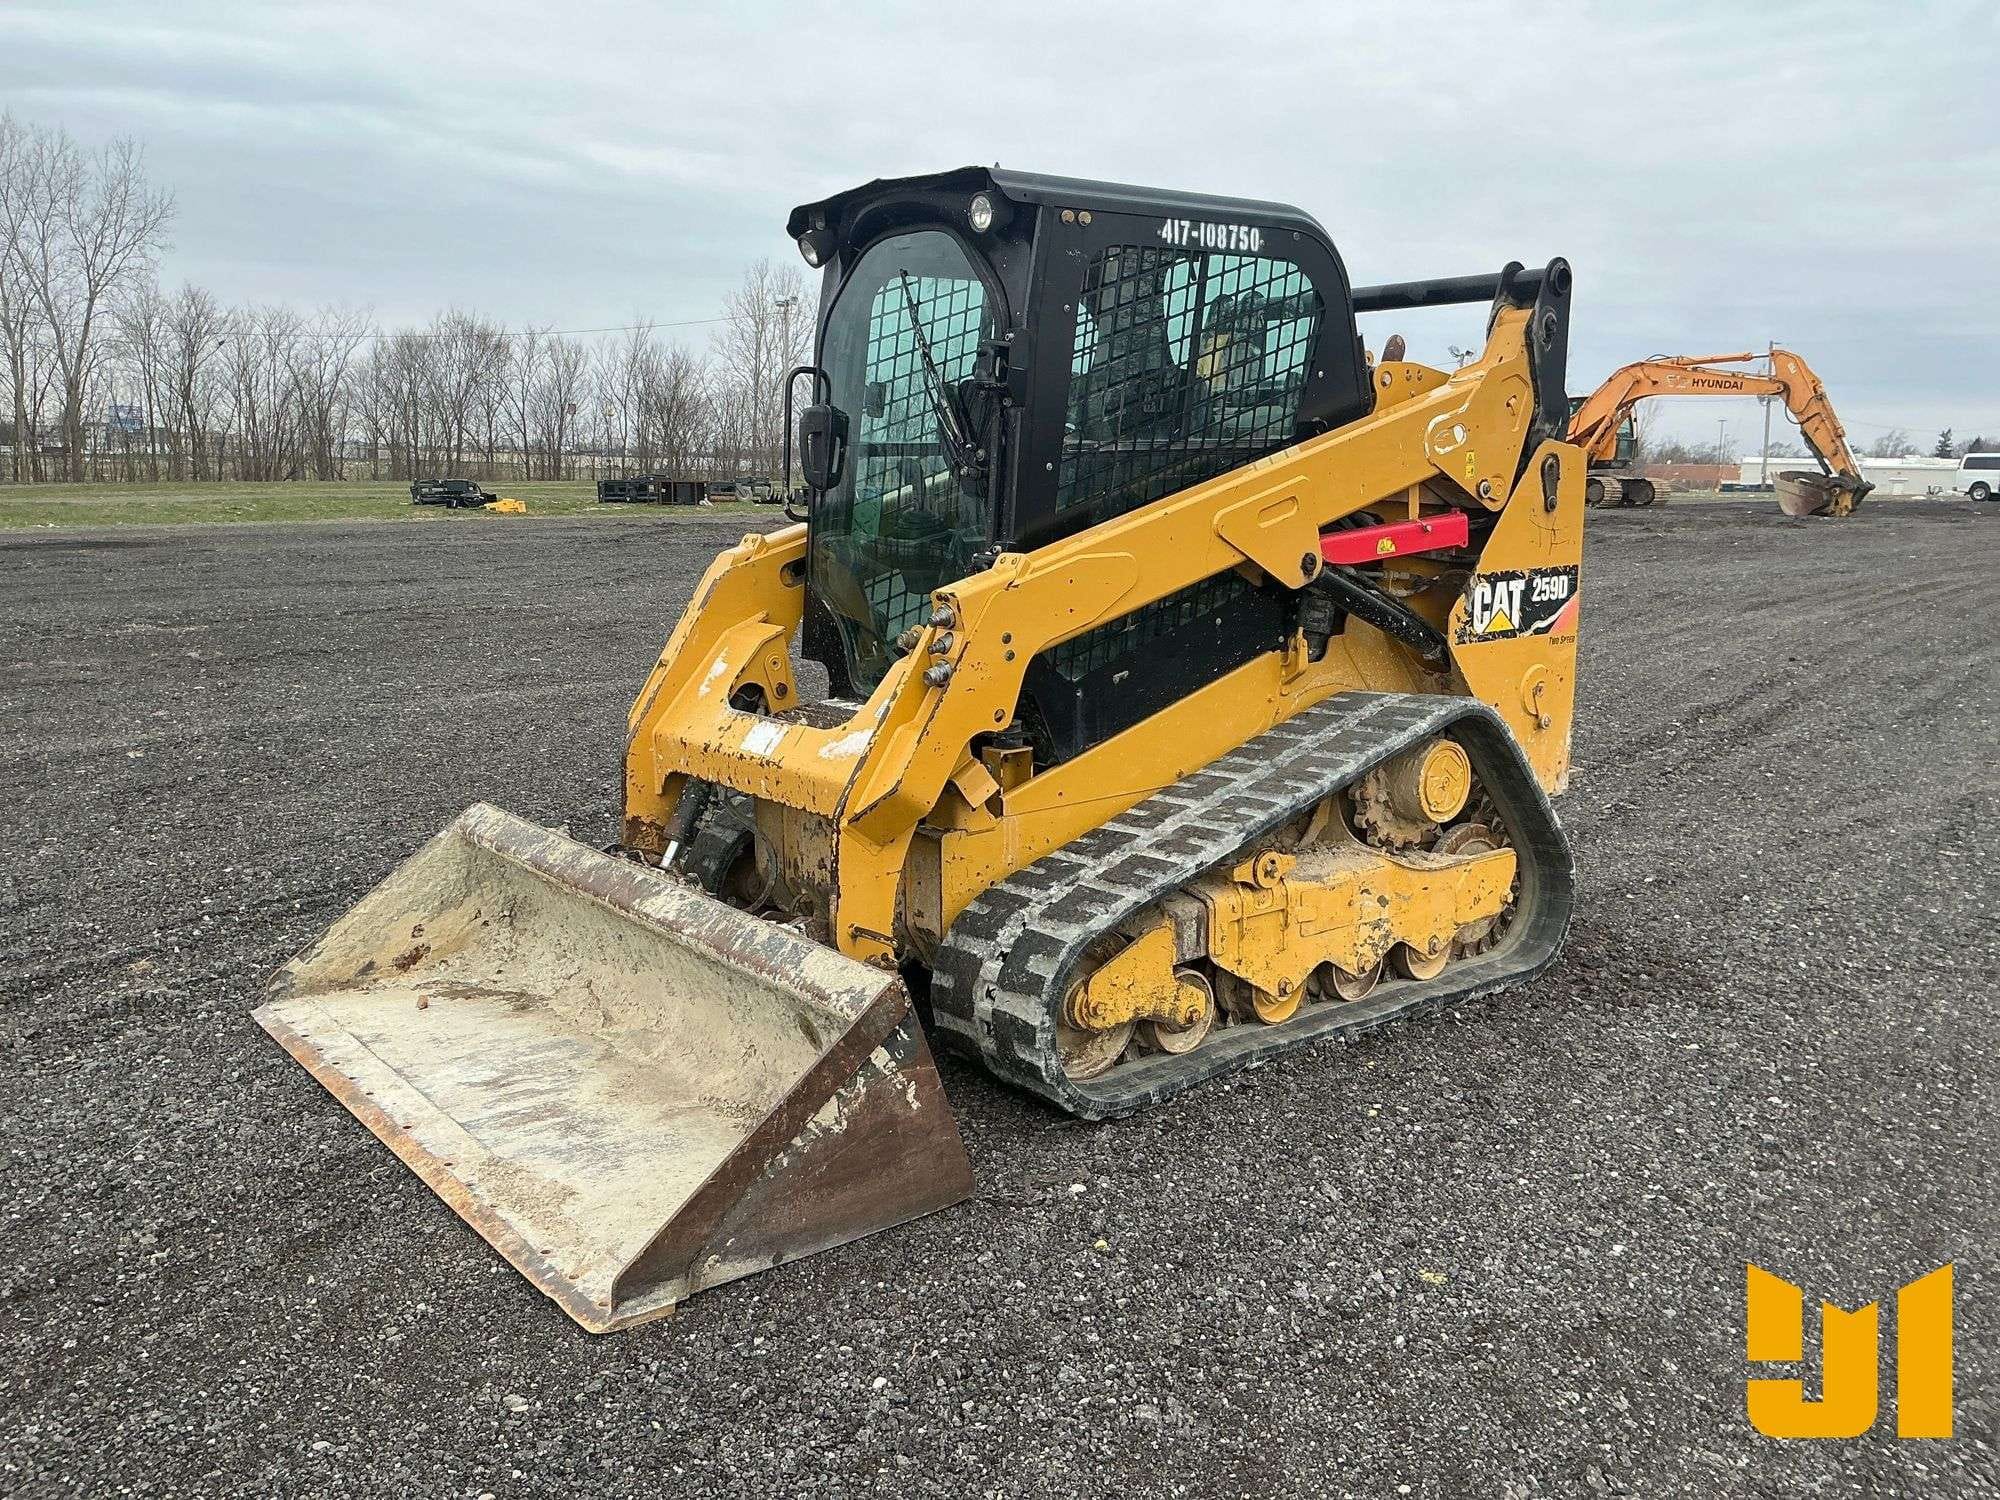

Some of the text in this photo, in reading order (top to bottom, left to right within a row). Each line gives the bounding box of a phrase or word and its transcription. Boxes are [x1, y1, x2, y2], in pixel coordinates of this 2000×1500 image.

[1161, 219, 1260, 252] 417-108750
[1691, 378, 1744, 390] HYUNDAI
[1473, 575, 1568, 633] CAT 259D
